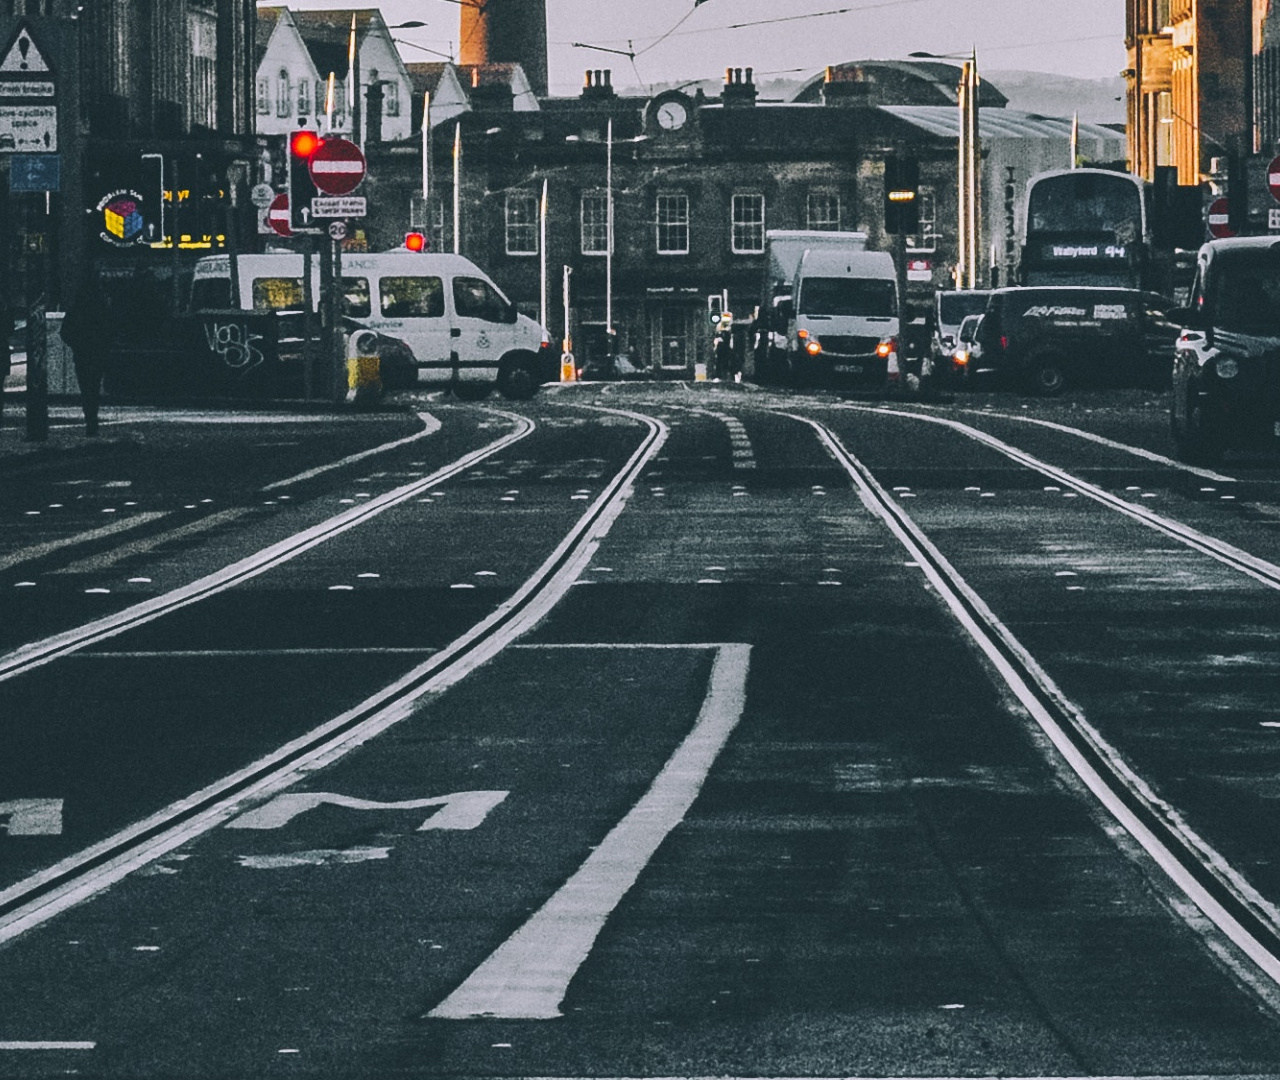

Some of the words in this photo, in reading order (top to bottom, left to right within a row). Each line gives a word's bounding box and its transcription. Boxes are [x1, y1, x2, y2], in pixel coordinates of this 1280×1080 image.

[23, 85, 54, 95] tracks
[18, 108, 54, 119] cyclists
[11, 120, 39, 130] space
[329, 224, 346, 235] 20
[1053, 246, 1098, 258] Wallyford
[1104, 245, 1126, 258] 44
